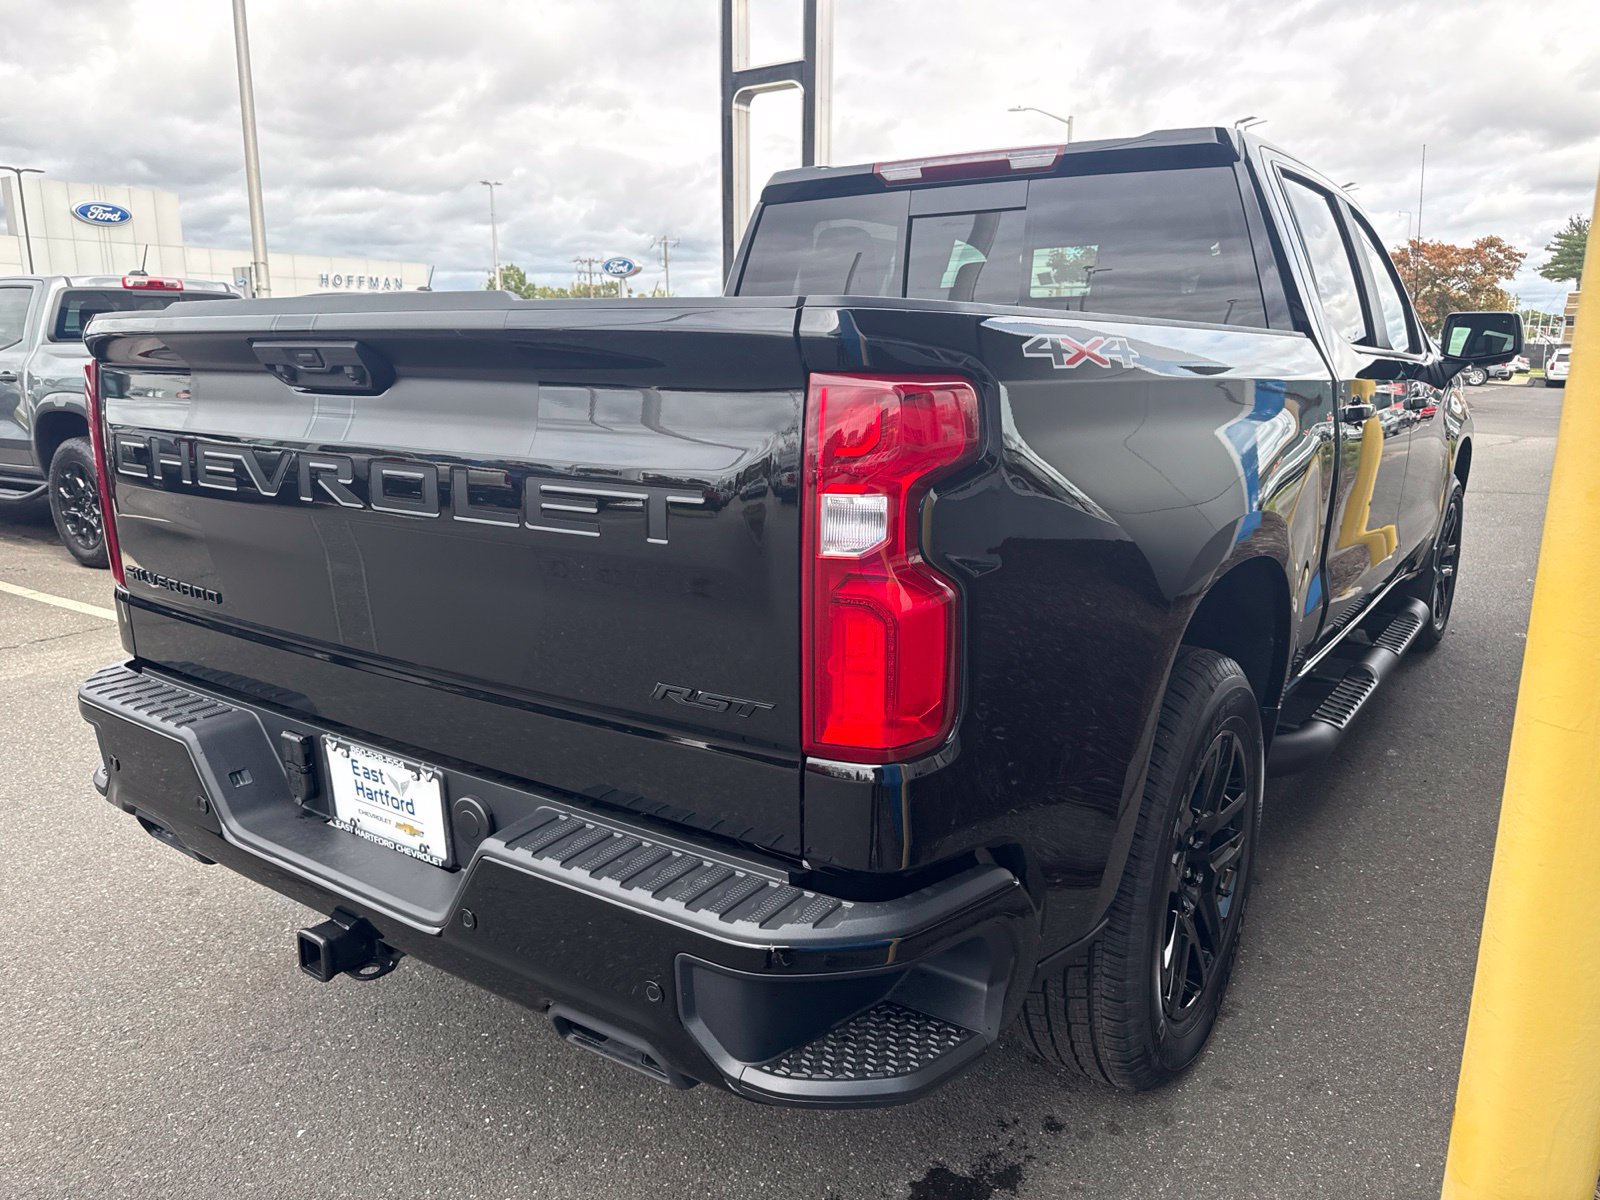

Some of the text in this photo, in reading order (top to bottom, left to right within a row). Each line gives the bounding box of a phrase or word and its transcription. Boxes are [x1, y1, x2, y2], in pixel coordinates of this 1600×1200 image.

[87, 205, 121, 222] Ford
[608, 260, 630, 273] Ford
[319, 273, 403, 290] HOFFMAN
[113, 432, 705, 545] CHEVROLET
[125, 565, 223, 604] SILVERADO
[648, 681, 777, 718] RST
[350, 746, 405, 769] 860-528-1554
[351, 758, 386, 785] East
[354, 779, 415, 816] Hartford
[358, 808, 392, 825] CHEVROLET
[335, 819, 443, 867] EAST HARTFORD CHEVROLET
